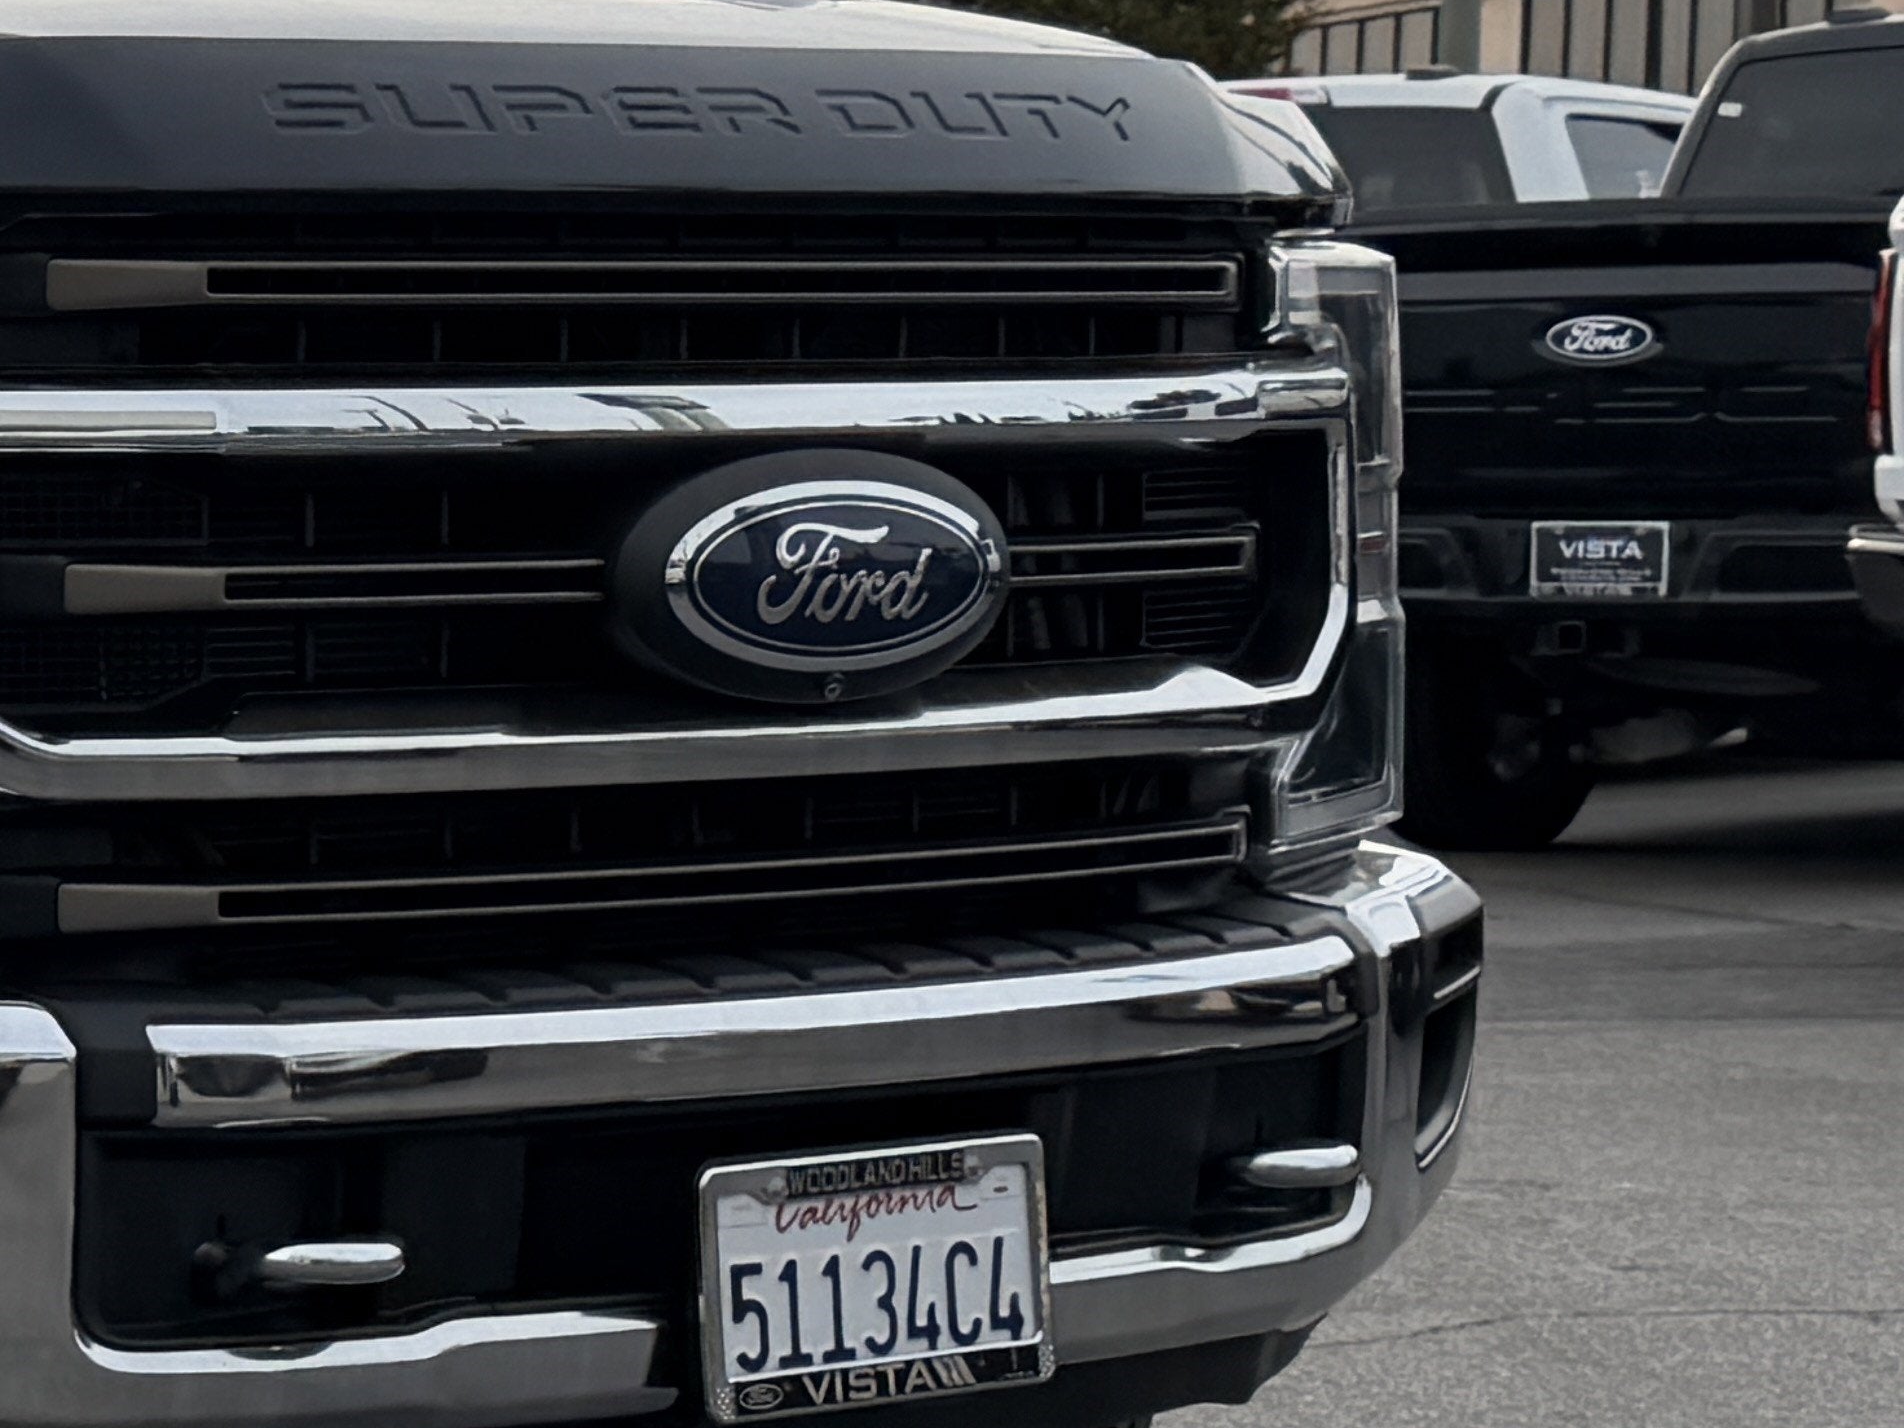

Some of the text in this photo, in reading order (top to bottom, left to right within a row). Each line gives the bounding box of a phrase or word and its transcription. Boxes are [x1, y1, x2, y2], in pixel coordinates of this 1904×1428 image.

[262, 80, 1133, 143] SUPER DUTY
[1563, 321, 1633, 352] Ford
[755, 521, 933, 626] Ford
[1558, 539, 1644, 561] VISTA
[789, 1150, 964, 1196] WOODLAND HILLS
[774, 1183, 978, 1243] California
[729, 1235, 1025, 1373] 51134C4
[801, 1362, 938, 1405] VISTA
